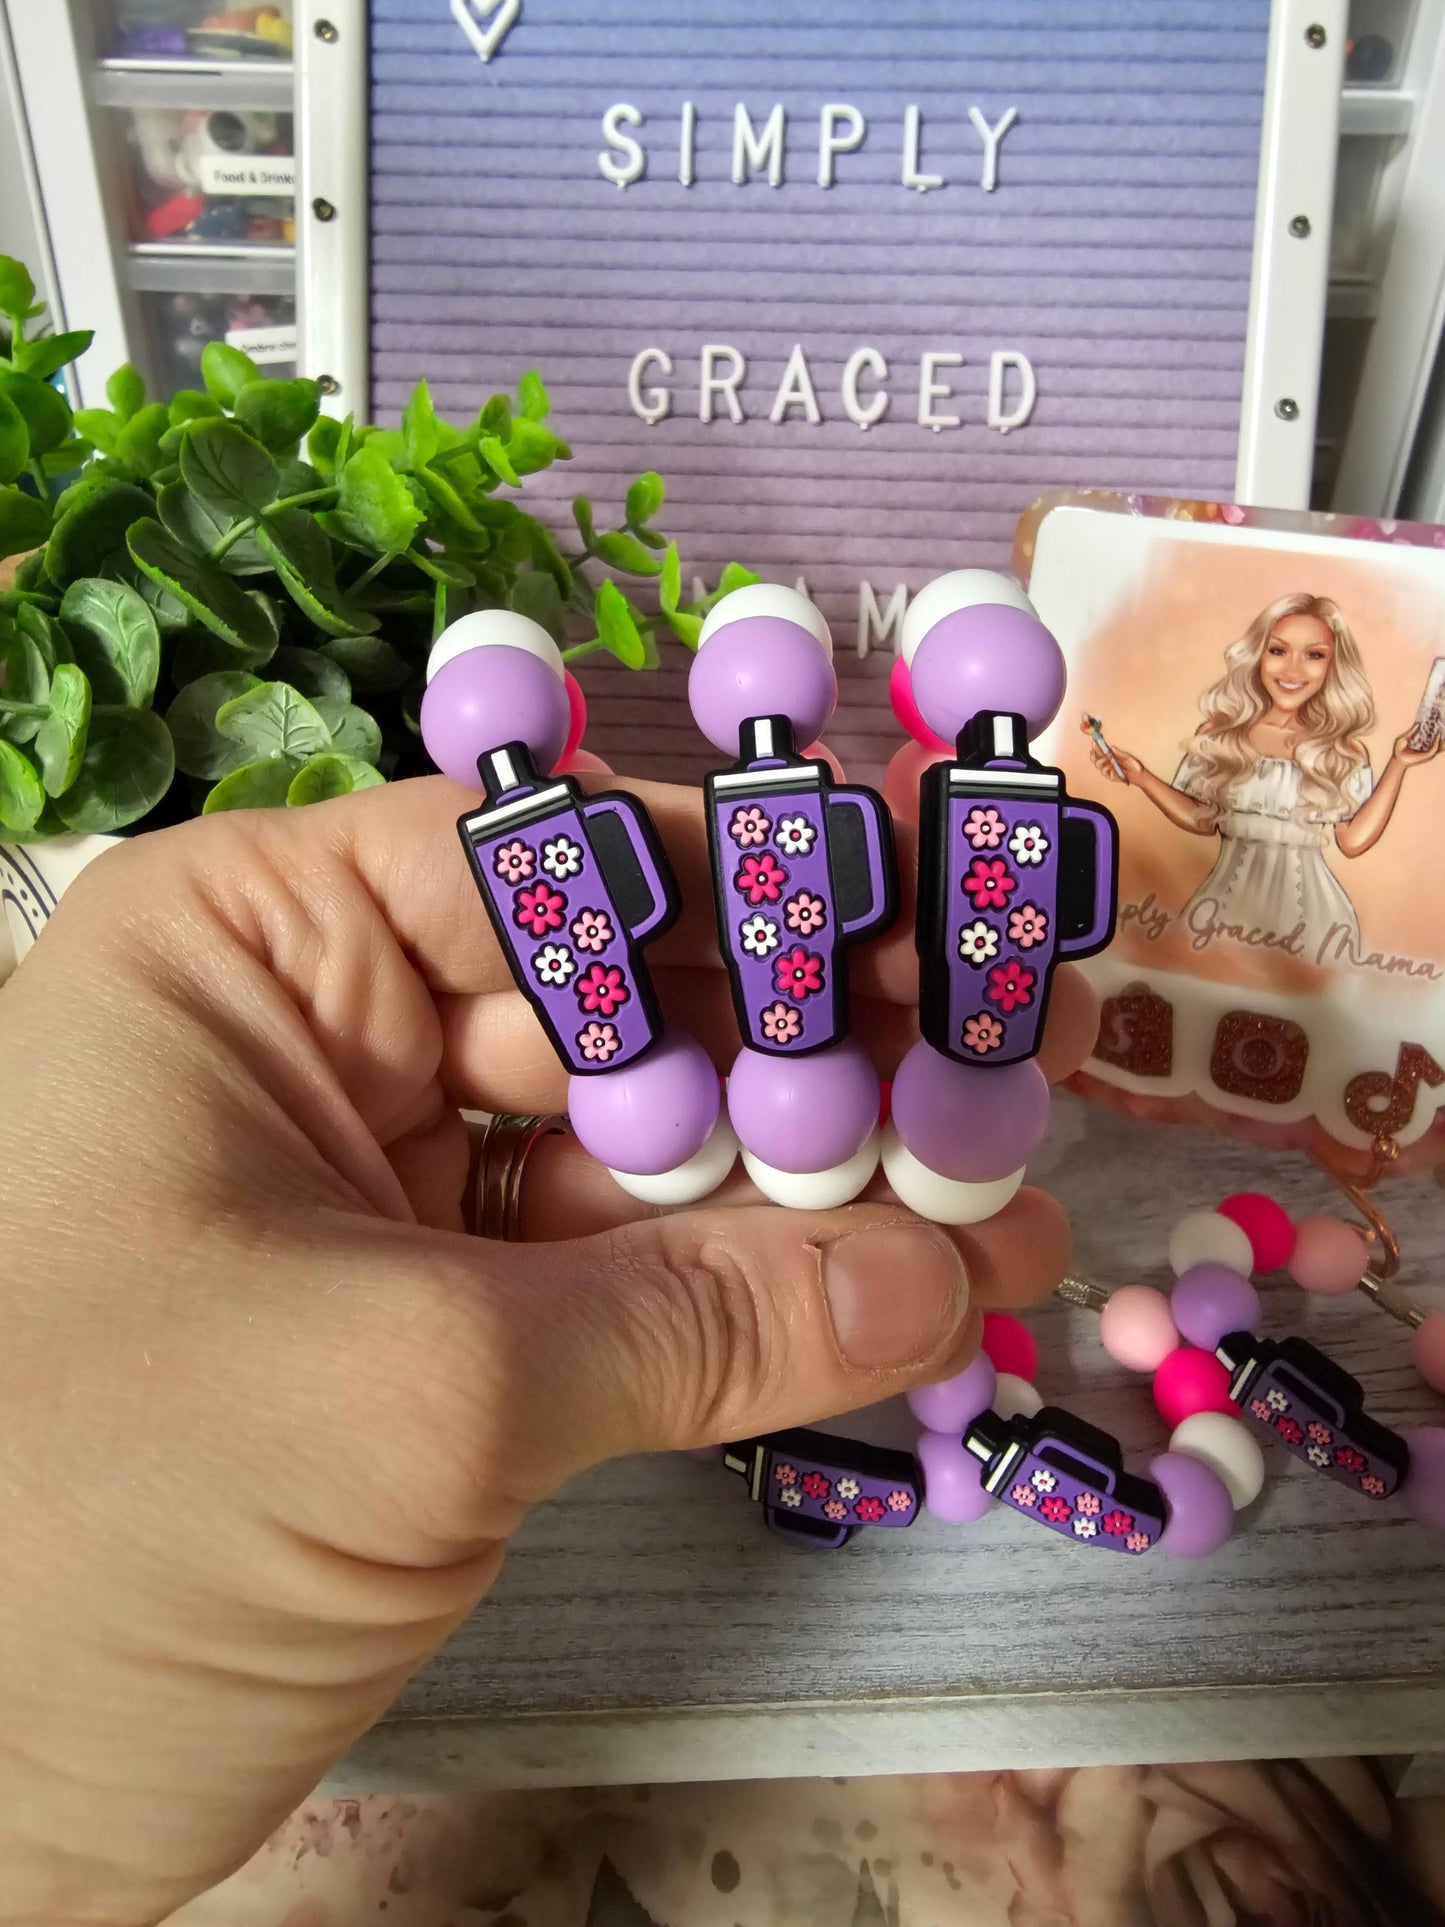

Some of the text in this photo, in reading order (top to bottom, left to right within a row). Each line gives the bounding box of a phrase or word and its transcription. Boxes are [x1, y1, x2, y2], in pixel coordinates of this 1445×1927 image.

[213, 169, 245, 184] Food
[598, 101, 1019, 191] SIMPLY
[628, 343, 1038, 432] GRACED
[1118, 893, 1444, 981] ply Graced Mama
